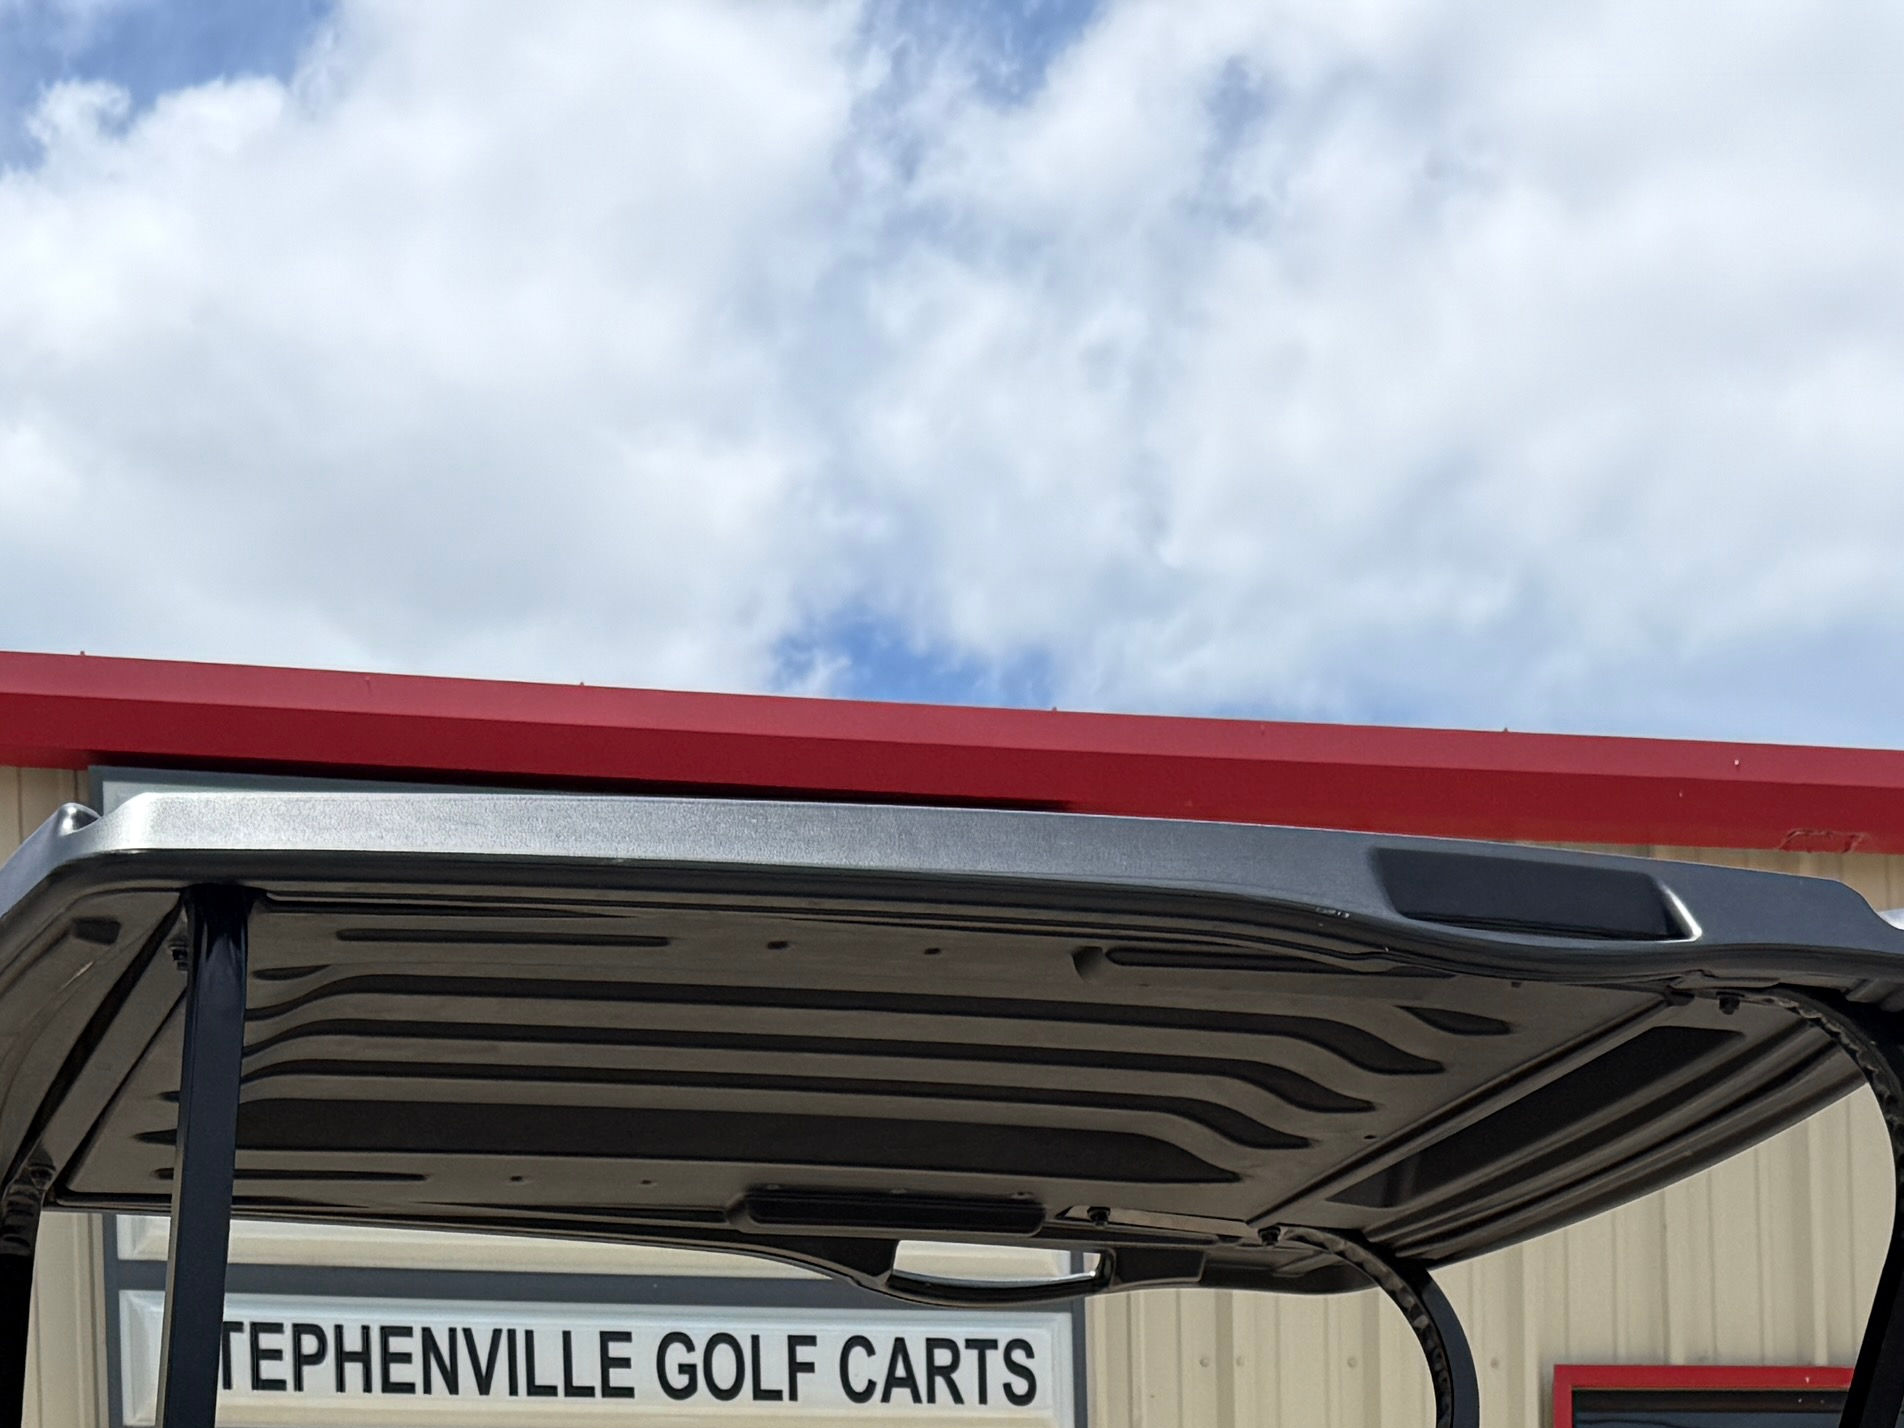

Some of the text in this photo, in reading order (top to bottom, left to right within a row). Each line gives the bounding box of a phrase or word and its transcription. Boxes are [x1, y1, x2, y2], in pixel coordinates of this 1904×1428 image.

[220, 1320, 1038, 1406] TEPHENVILLE GOLF CARTS
